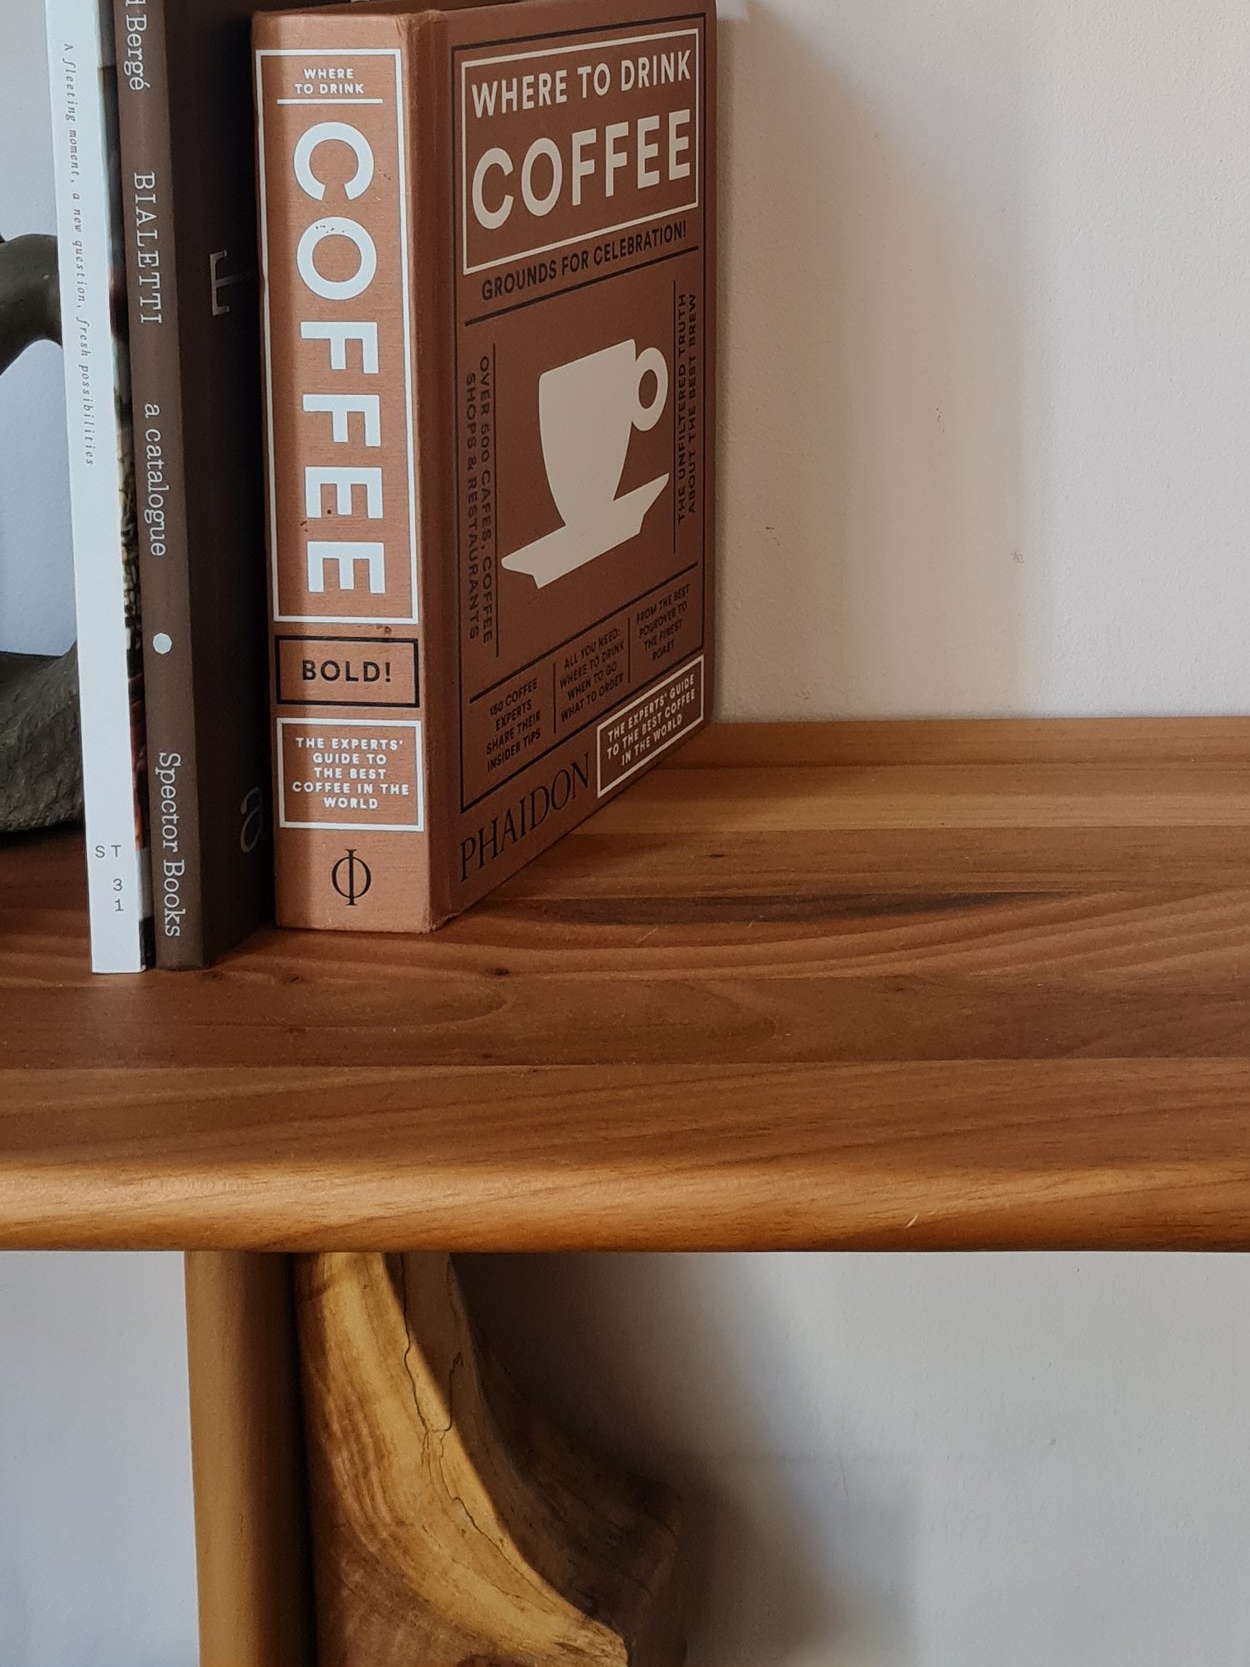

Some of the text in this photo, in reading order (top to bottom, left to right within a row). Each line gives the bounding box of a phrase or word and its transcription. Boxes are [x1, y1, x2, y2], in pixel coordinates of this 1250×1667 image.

[123, 14, 150, 91] Bergé
[304, 68, 354, 79] WHERE
[62, 58, 78, 122] fleeting
[295, 83, 364, 94] TO DRINK
[472, 49, 692, 118] WHERE TO DRINK
[69, 129, 80, 183] moment,
[472, 108, 691, 230] COFFEE
[72, 192, 80, 200] a
[73, 208, 82, 233] new
[134, 172, 162, 324] BIALETTI
[481, 220, 687, 301] GROUNDS FOR CELEBRATION!
[72, 240, 87, 308] question,
[76, 317, 91, 356] fresh
[293, 121, 386, 595] COFFEE
[480, 356, 490, 415] OVER
[678, 294, 686, 525] THE UNFILTERED TRUTH
[688, 294, 696, 513] ABOUT THE BEST BREW
[78, 364, 96, 465] possibilities
[144, 403, 169, 557] a catalogue
[467, 372, 479, 640] SHOPS & RESTAURANTS
[482, 556, 493, 644] COFFEE
[302, 659, 391, 682] BOLD!
[564, 653, 578, 670] ALL
[581, 642, 597, 658] YOU
[589, 657, 599, 670] TO
[505, 677, 538, 707] COFFEE
[567, 662, 617, 701] WHEN TO GO
[496, 699, 532, 731] EXPERTS
[561, 700, 584, 722] WHAT
[587, 691, 597, 704] TO
[607, 722, 625, 742] THE
[670, 674, 694, 699] GUIDE
[607, 688, 695, 760] TO THE BEST COFFEE
[295, 737, 325, 748] THE
[486, 711, 540, 755] SHARE THEIR
[487, 728, 541, 772] INSIDER TIPS
[621, 713, 683, 766] IN THE WORLD
[312, 752, 387, 765] GUIDE TO
[314, 767, 386, 780] THE BEST
[292, 781, 409, 796] COFFEE IN THE
[323, 797, 378, 809] WORLD
[459, 751, 590, 883] PHAIDON
[155, 752, 186, 938] Spector Books
[112, 878, 123, 892] 3
[114, 898, 124, 912] 1
